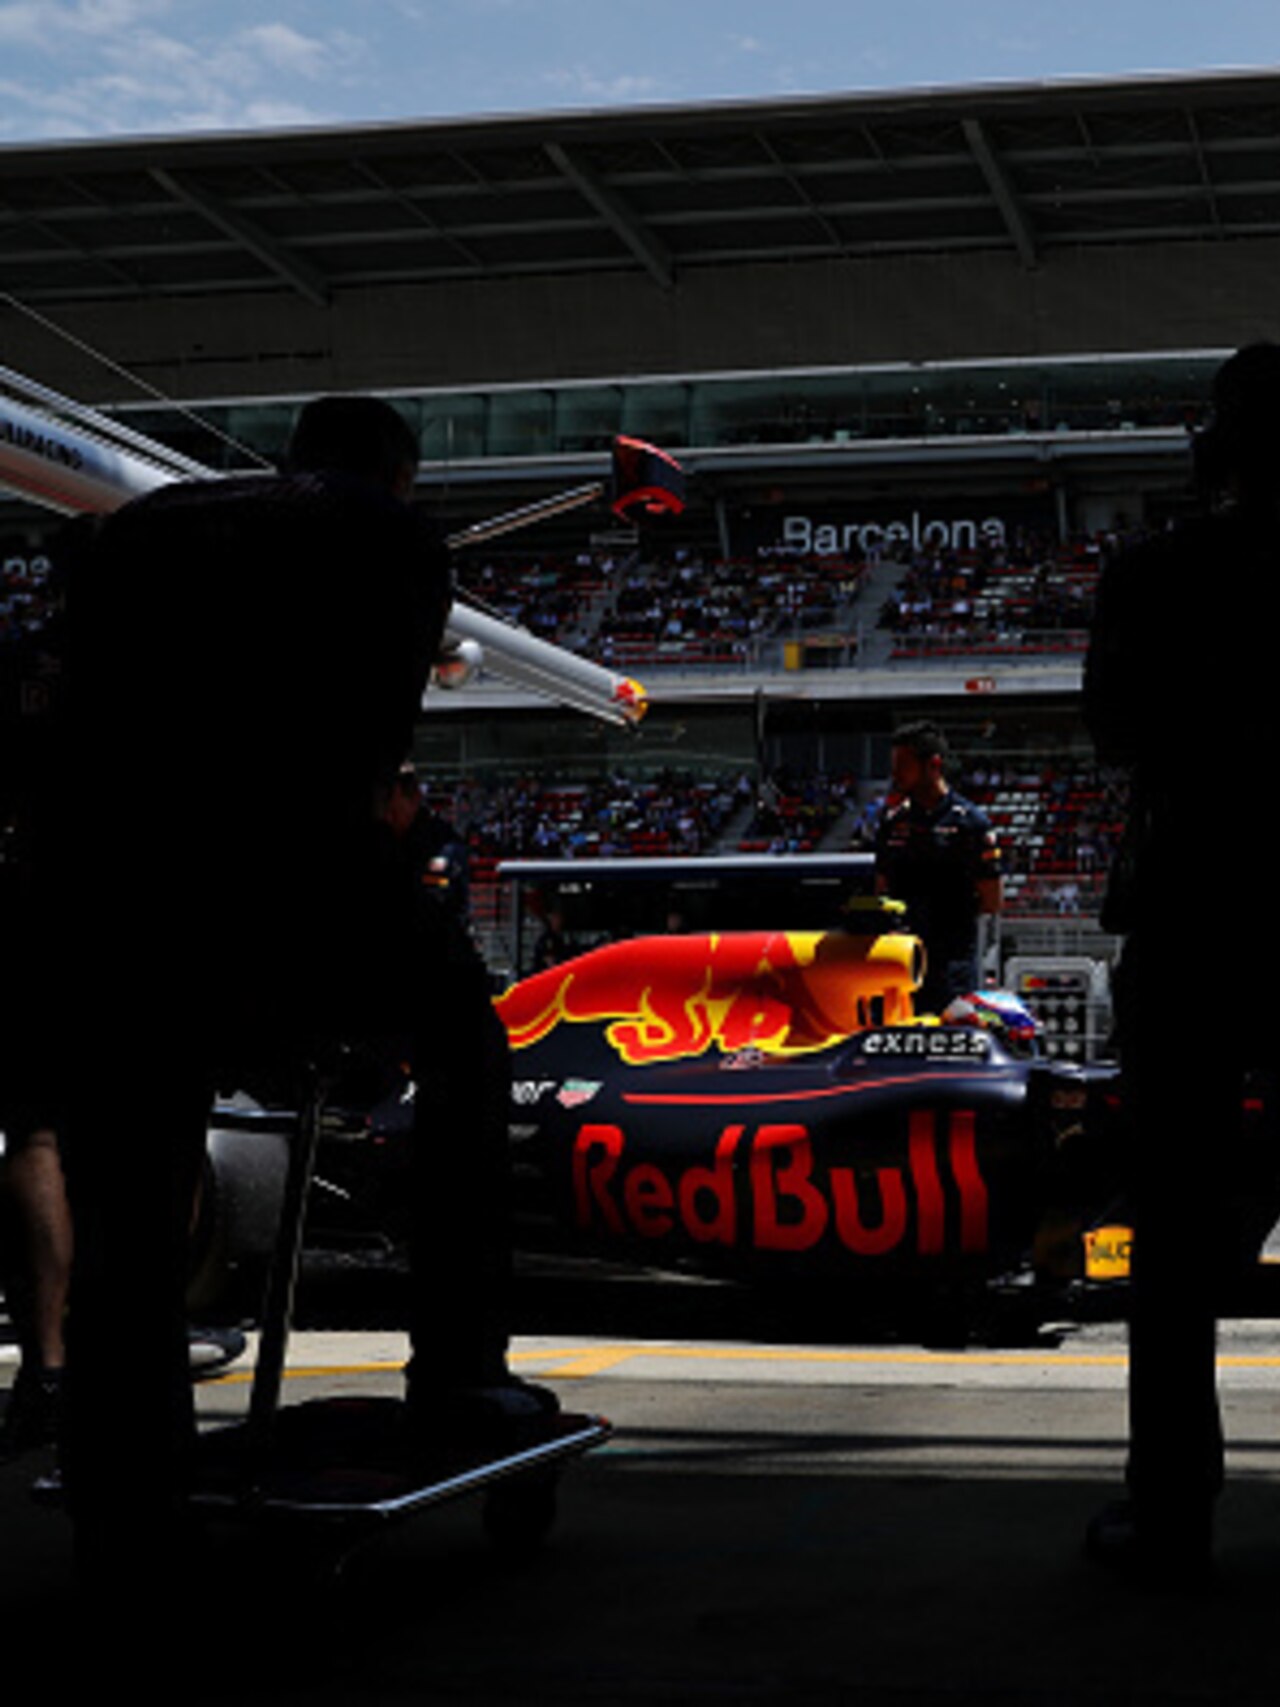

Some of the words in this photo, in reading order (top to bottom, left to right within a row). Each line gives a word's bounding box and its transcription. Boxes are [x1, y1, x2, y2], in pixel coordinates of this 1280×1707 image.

[783, 511, 1006, 556] Barcelona
[862, 1032, 989, 1054] exness
[572, 1124, 746, 1250] Red
[749, 1110, 989, 1256] Bull
